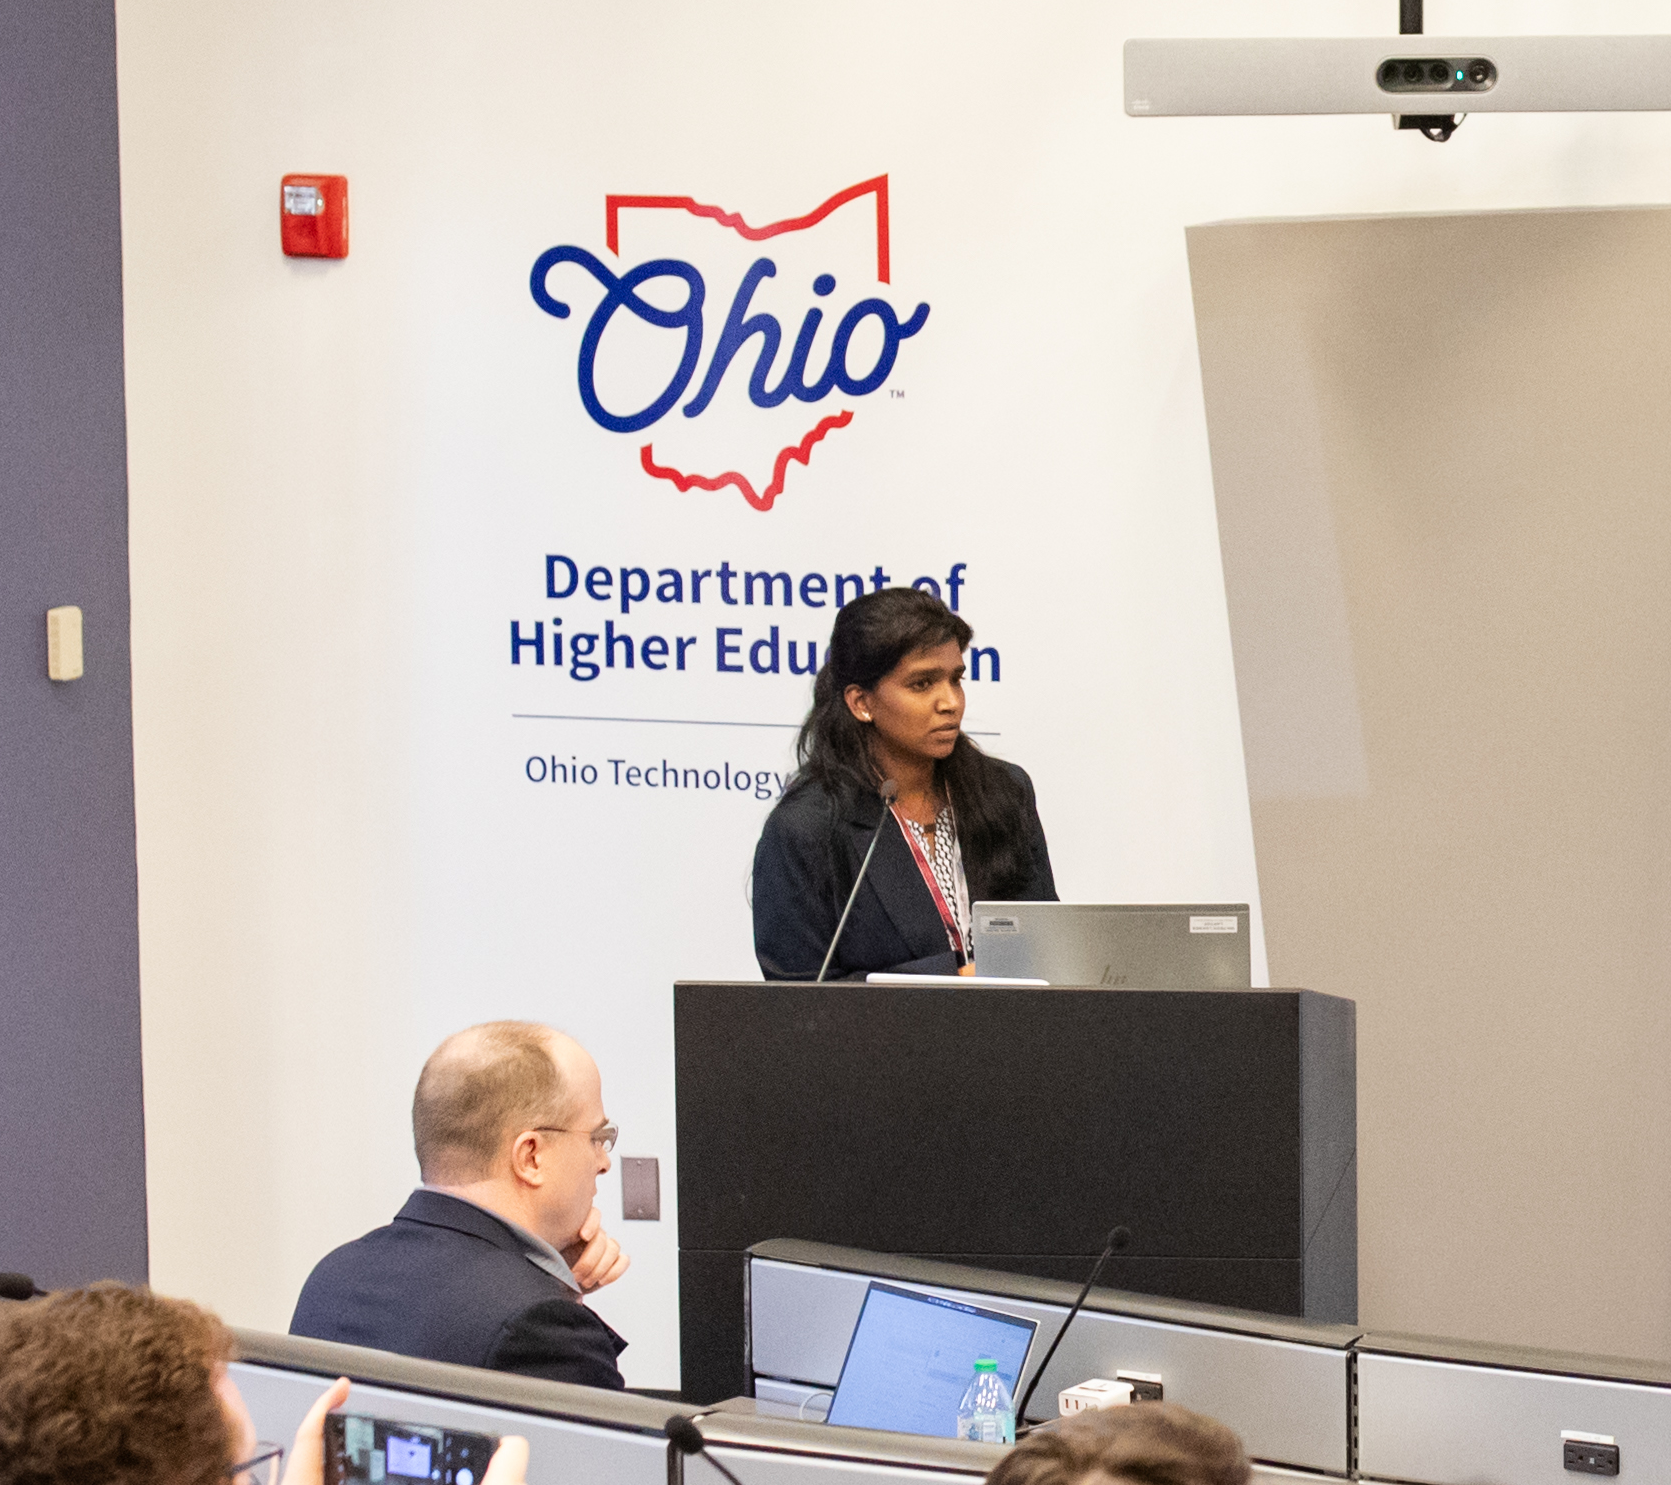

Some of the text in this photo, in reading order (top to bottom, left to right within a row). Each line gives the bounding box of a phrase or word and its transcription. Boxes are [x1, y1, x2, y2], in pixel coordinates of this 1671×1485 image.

[530, 244, 931, 434] Ohio
[545, 553, 891, 614] Department
[511, 617, 697, 683] Higher
[525, 754, 790, 801] Ohio Technology
